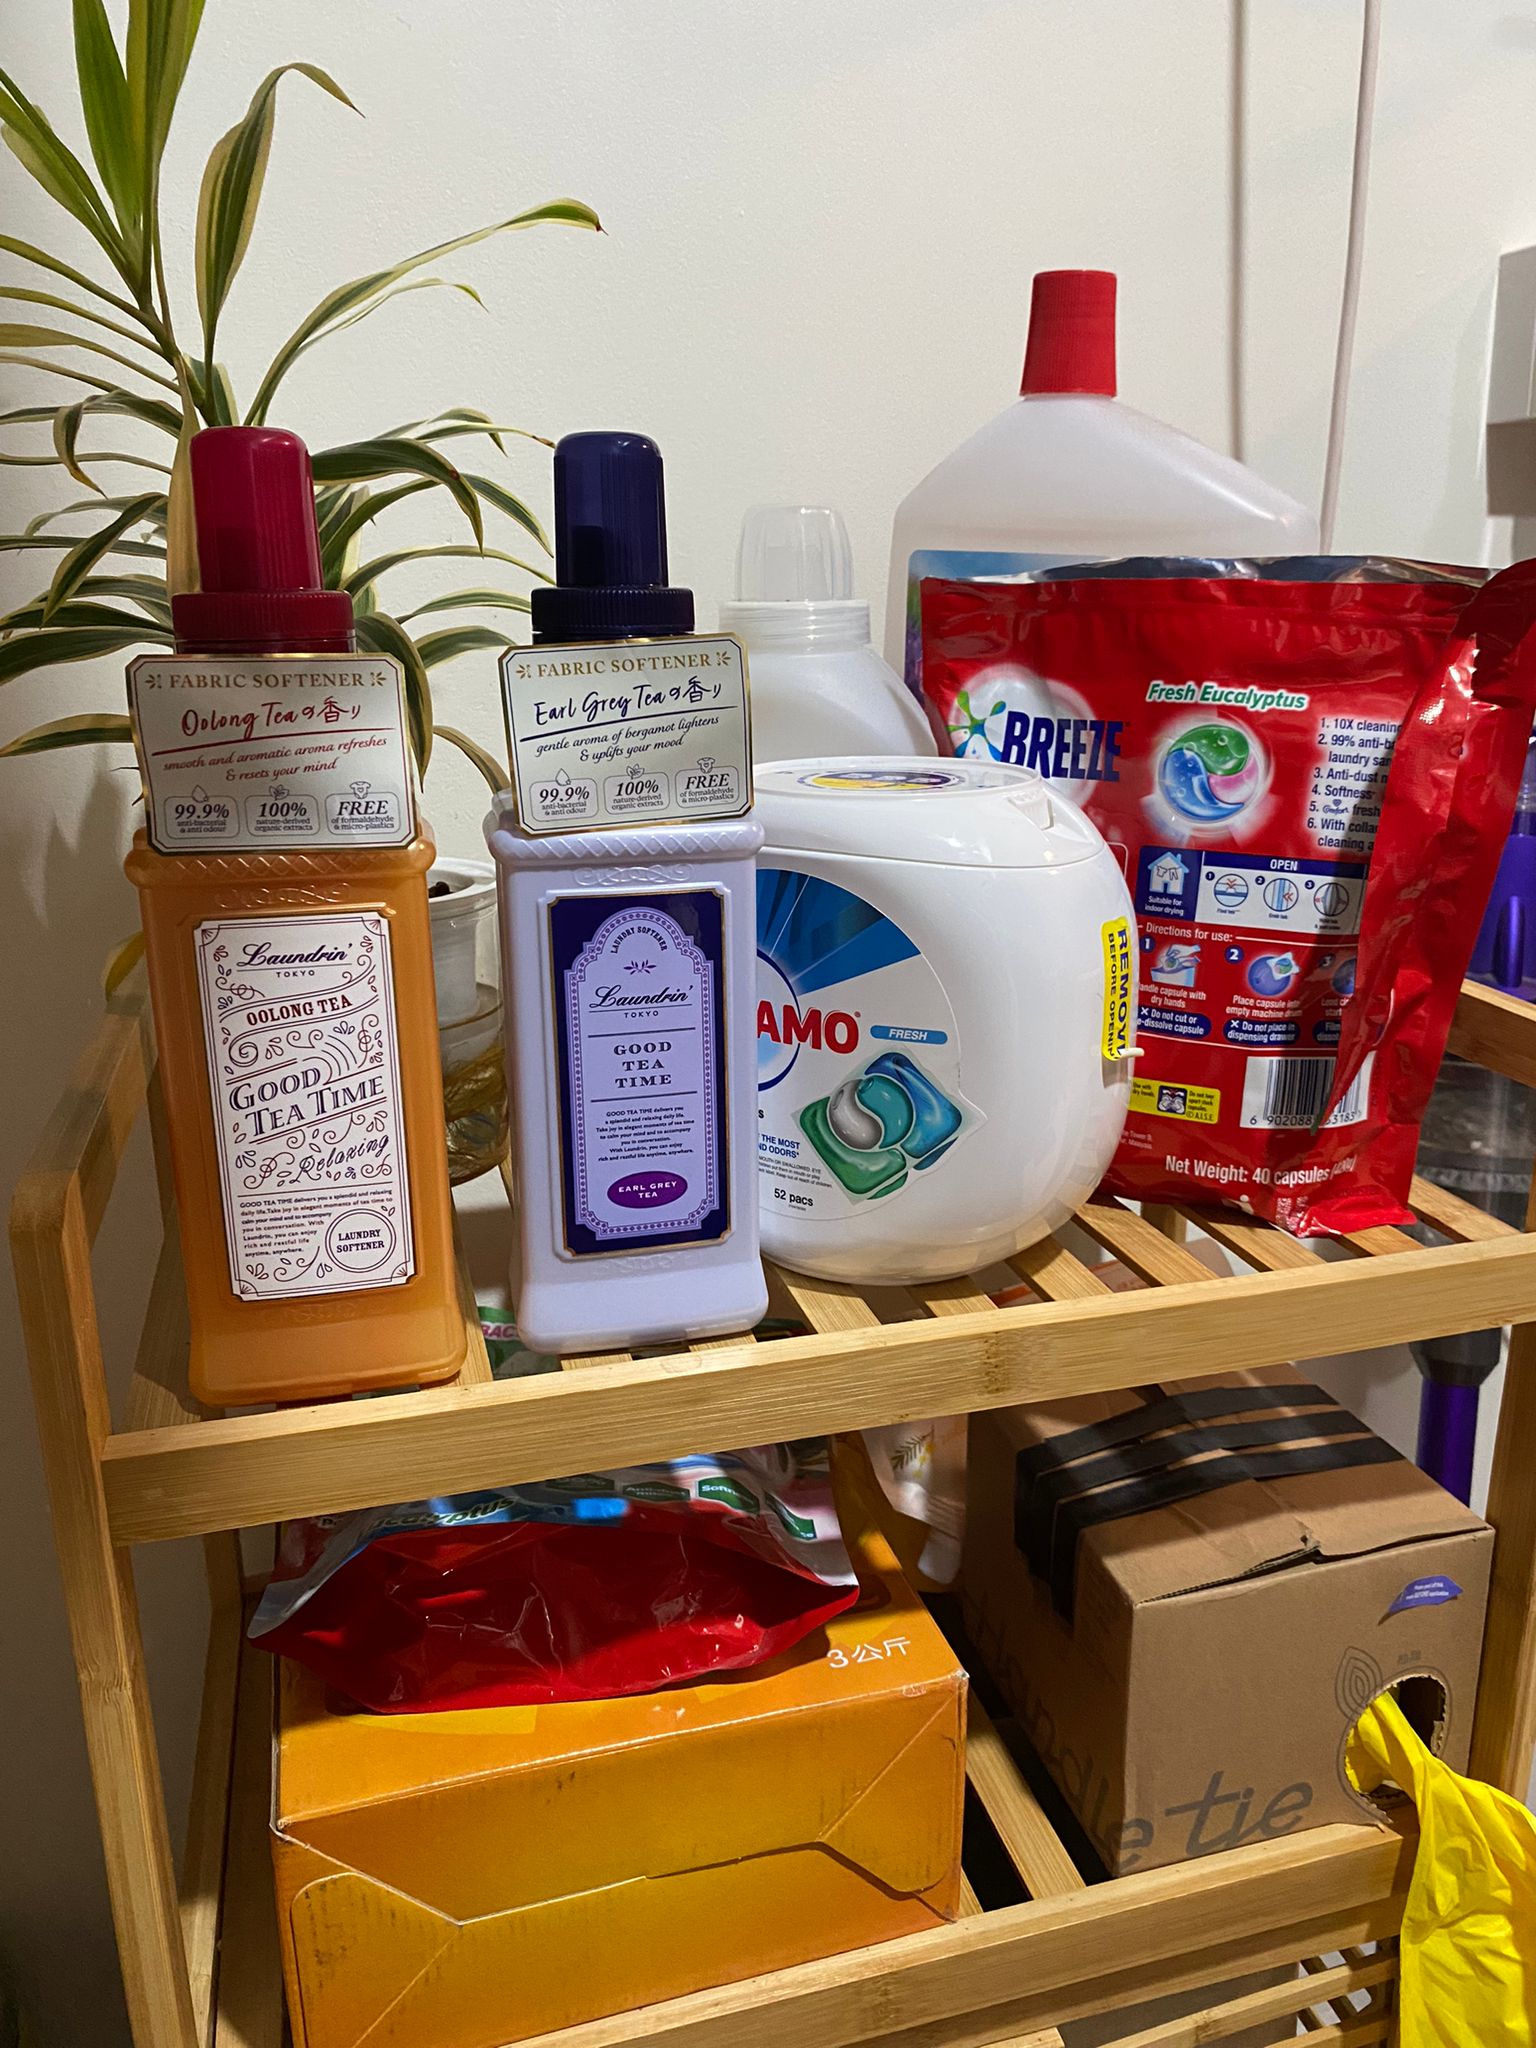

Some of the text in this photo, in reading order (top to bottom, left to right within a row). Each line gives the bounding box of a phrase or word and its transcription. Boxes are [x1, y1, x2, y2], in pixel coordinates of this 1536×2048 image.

[537, 653, 712, 677] FABRIC SOFTENER
[170, 673, 364, 688] FABRIC SOFTENER
[1148, 684, 1306, 709] Fresh Eucalyptus
[534, 698, 576, 725] Earl
[582, 692, 632, 722] Grey
[633, 684, 666, 705] Tea
[182, 709, 259, 738] Oolong
[262, 702, 297, 726] Tea
[1321, 718, 1329, 728] 1.
[1334, 719, 1354, 730] 10X
[534, 716, 719, 757] gentle aroma of bergamot lightens
[1318, 734, 1327, 744] 2.
[1331, 735, 1355, 747] 99%
[580, 736, 685, 765] & uplifts your mood
[1000, 710, 1124, 782] BREEZE
[164, 736, 387, 771] smooth and aromatic aroma refreshes
[1328, 751, 1370, 767] laundry
[225, 759, 336, 782] & resets your mind
[1314, 767, 1323, 778] 3.
[1327, 768, 1378, 781] Anti-dust
[616, 780, 659, 796] 100%
[685, 773, 729, 789] FREE
[540, 786, 589, 803] 99.9%
[688, 787, 734, 797] formaldehyde
[1312, 784, 1321, 795] 4.
[542, 801, 586, 810] anti-bacterial
[613, 794, 661, 804] nature-derived
[637, 800, 663, 808] extracts
[688, 794, 734, 803] micro-plastics
[175, 804, 229, 819] 99.9%
[259, 802, 307, 817] 100%
[338, 801, 388, 815] FREE
[1309, 801, 1319, 812] 5.
[341, 815, 394, 823] formaldehyde
[341, 822, 394, 830] micro-plastics
[1307, 818, 1316, 828] 6.
[1321, 818, 1345, 830] With
[1318, 836, 1364, 851] cleaning
[1270, 859, 1298, 871] OPEN
[1148, 896, 1182, 906] Suitable for
[1164, 906, 1184, 916] drying
[1146, 922, 1233, 942] Directions for use:
[610, 926, 667, 954] LAUNDRY SOFTENER
[1145, 938, 1238, 959] 1 2
[276, 970, 315, 978] TOKYO
[1108, 933, 1119, 1059] BEFORE OPENIN
[1139, 984, 1206, 1000] andle capsule with
[1151, 995, 1185, 1008] dry hands
[1232, 995, 1286, 1008] Place capsule
[246, 994, 352, 1026] OOLONG TEA
[1151, 1009, 1161, 1018] Do
[1162, 1012, 1173, 1020] not
[1175, 1015, 1187, 1023] cut
[1226, 1006, 1284, 1018] empty machine
[1174, 1024, 1204, 1035] capsule
[1242, 1021, 1286, 1032] Do not place
[889, 1028, 928, 1041] FRESH
[1228, 1030, 1268, 1042] dispensing
[614, 1041, 672, 1056] GOOD
[622, 1059, 664, 1071] TEA
[615, 1074, 672, 1089] TIME
[1250, 1115, 1312, 1126] 6 902088
[761, 1134, 800, 1149] THE MOST
[289, 1135, 389, 1183] Relaxing
[1165, 1154, 1190, 1173] Net
[1193, 1158, 1248, 1184] Weight:
[1252, 1167, 1270, 1184] 40
[1274, 1166, 1330, 1188] capsules
[618, 1181, 677, 1193] EARL GREY
[774, 1188, 813, 1206] 52 pacs
[338, 1229, 381, 1241] LAUNDRY
[337, 1240, 384, 1253] SOFTENER
